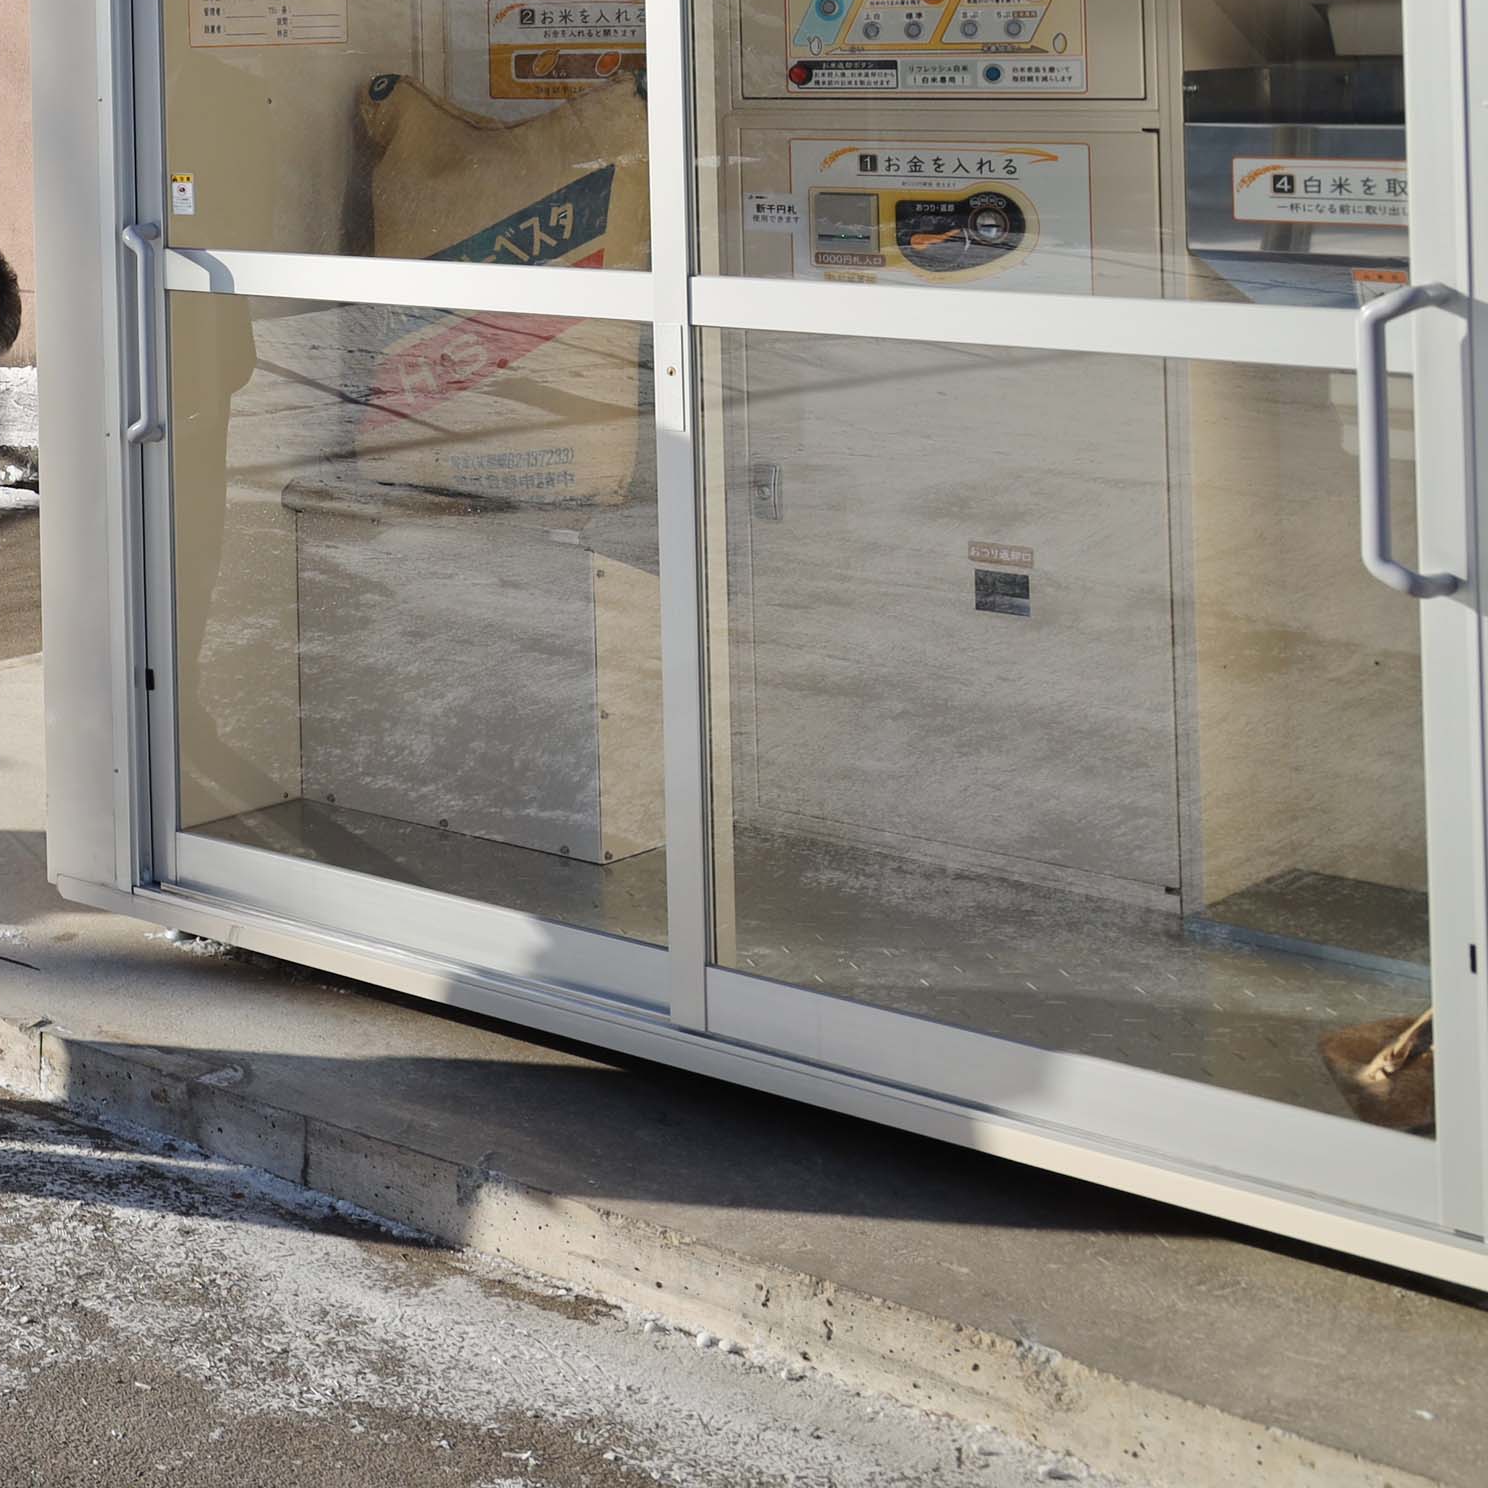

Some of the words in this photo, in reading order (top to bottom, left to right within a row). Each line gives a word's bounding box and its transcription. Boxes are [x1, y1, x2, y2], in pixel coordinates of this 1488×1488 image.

[884, 155, 1017, 175] お金を入れる
[818, 253, 882, 265] 1000円札入口
